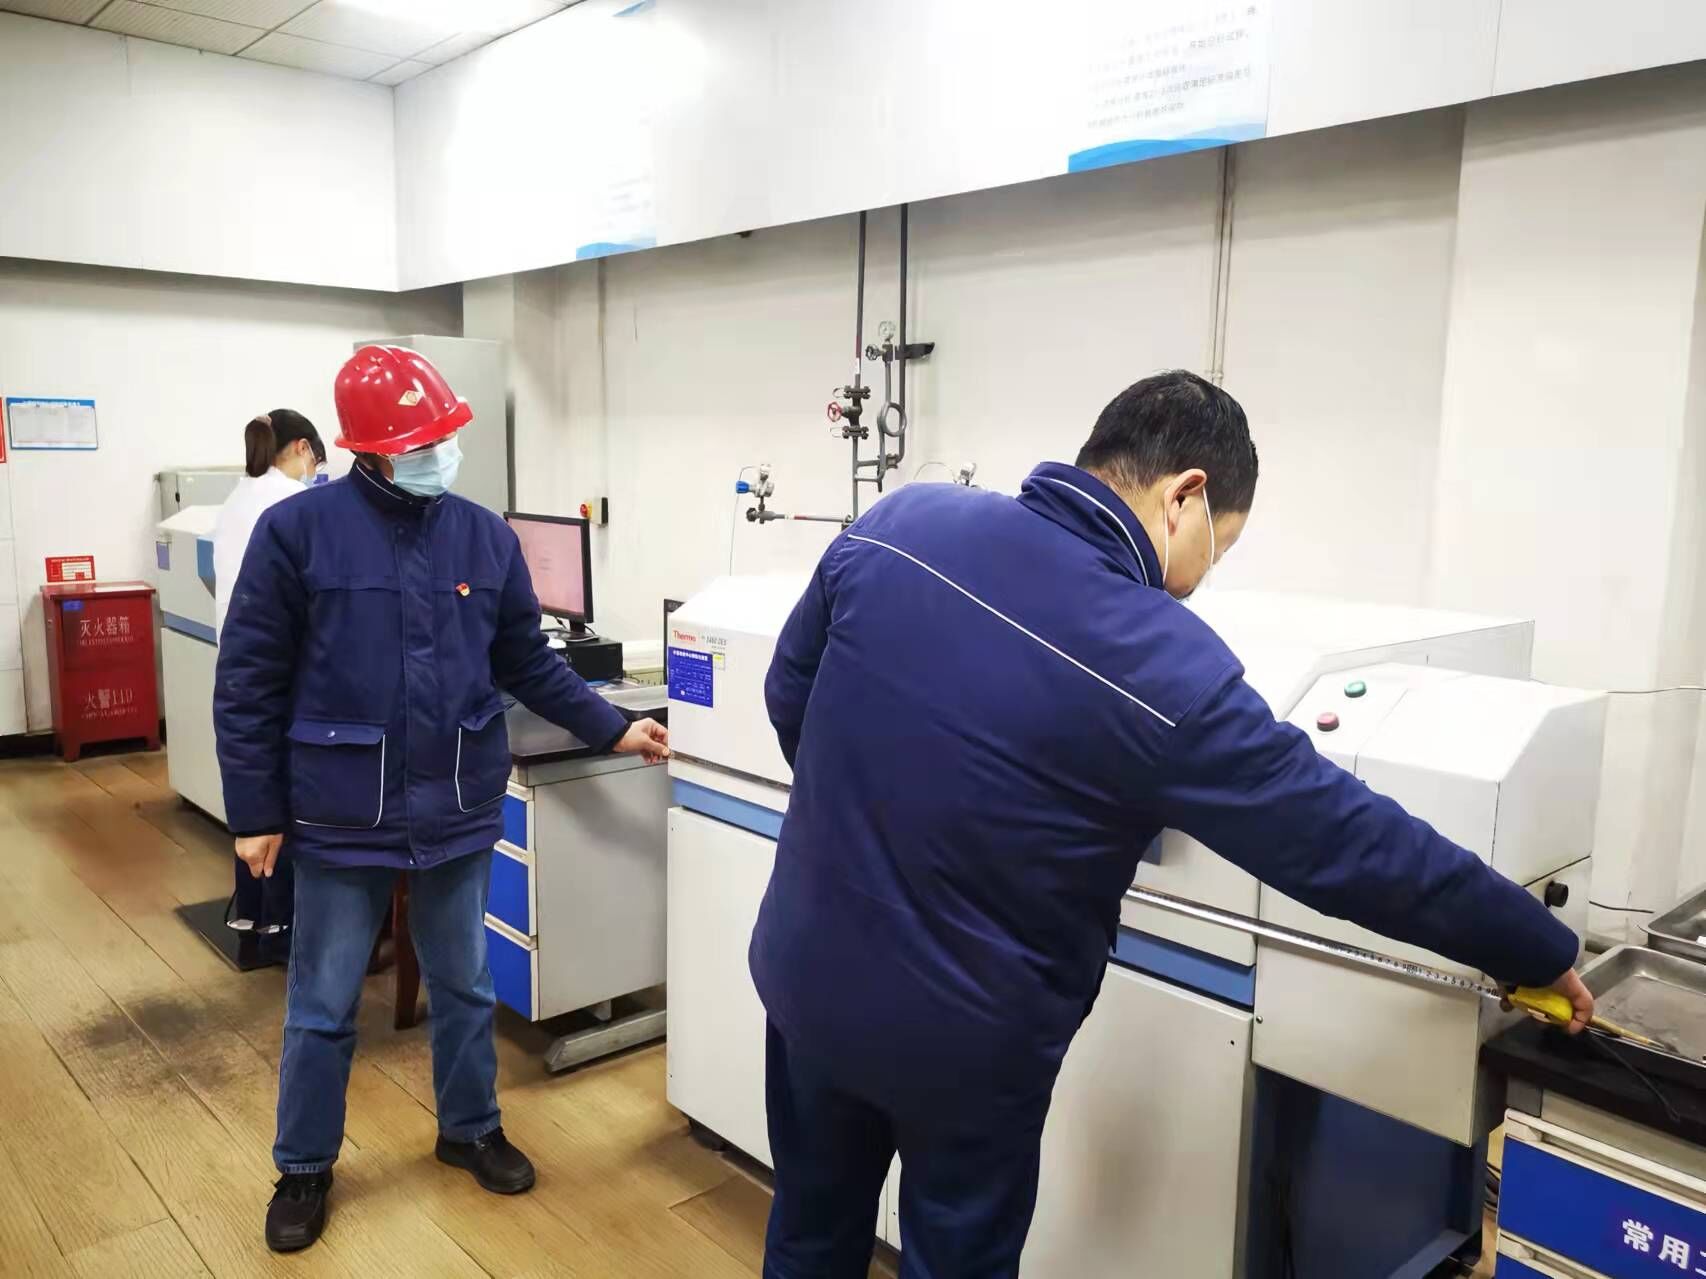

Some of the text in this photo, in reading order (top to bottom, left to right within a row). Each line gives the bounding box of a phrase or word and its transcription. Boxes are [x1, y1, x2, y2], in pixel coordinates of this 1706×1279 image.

[80, 616, 130, 637] 灭火器箱
[673, 630, 696, 642] Thermo
